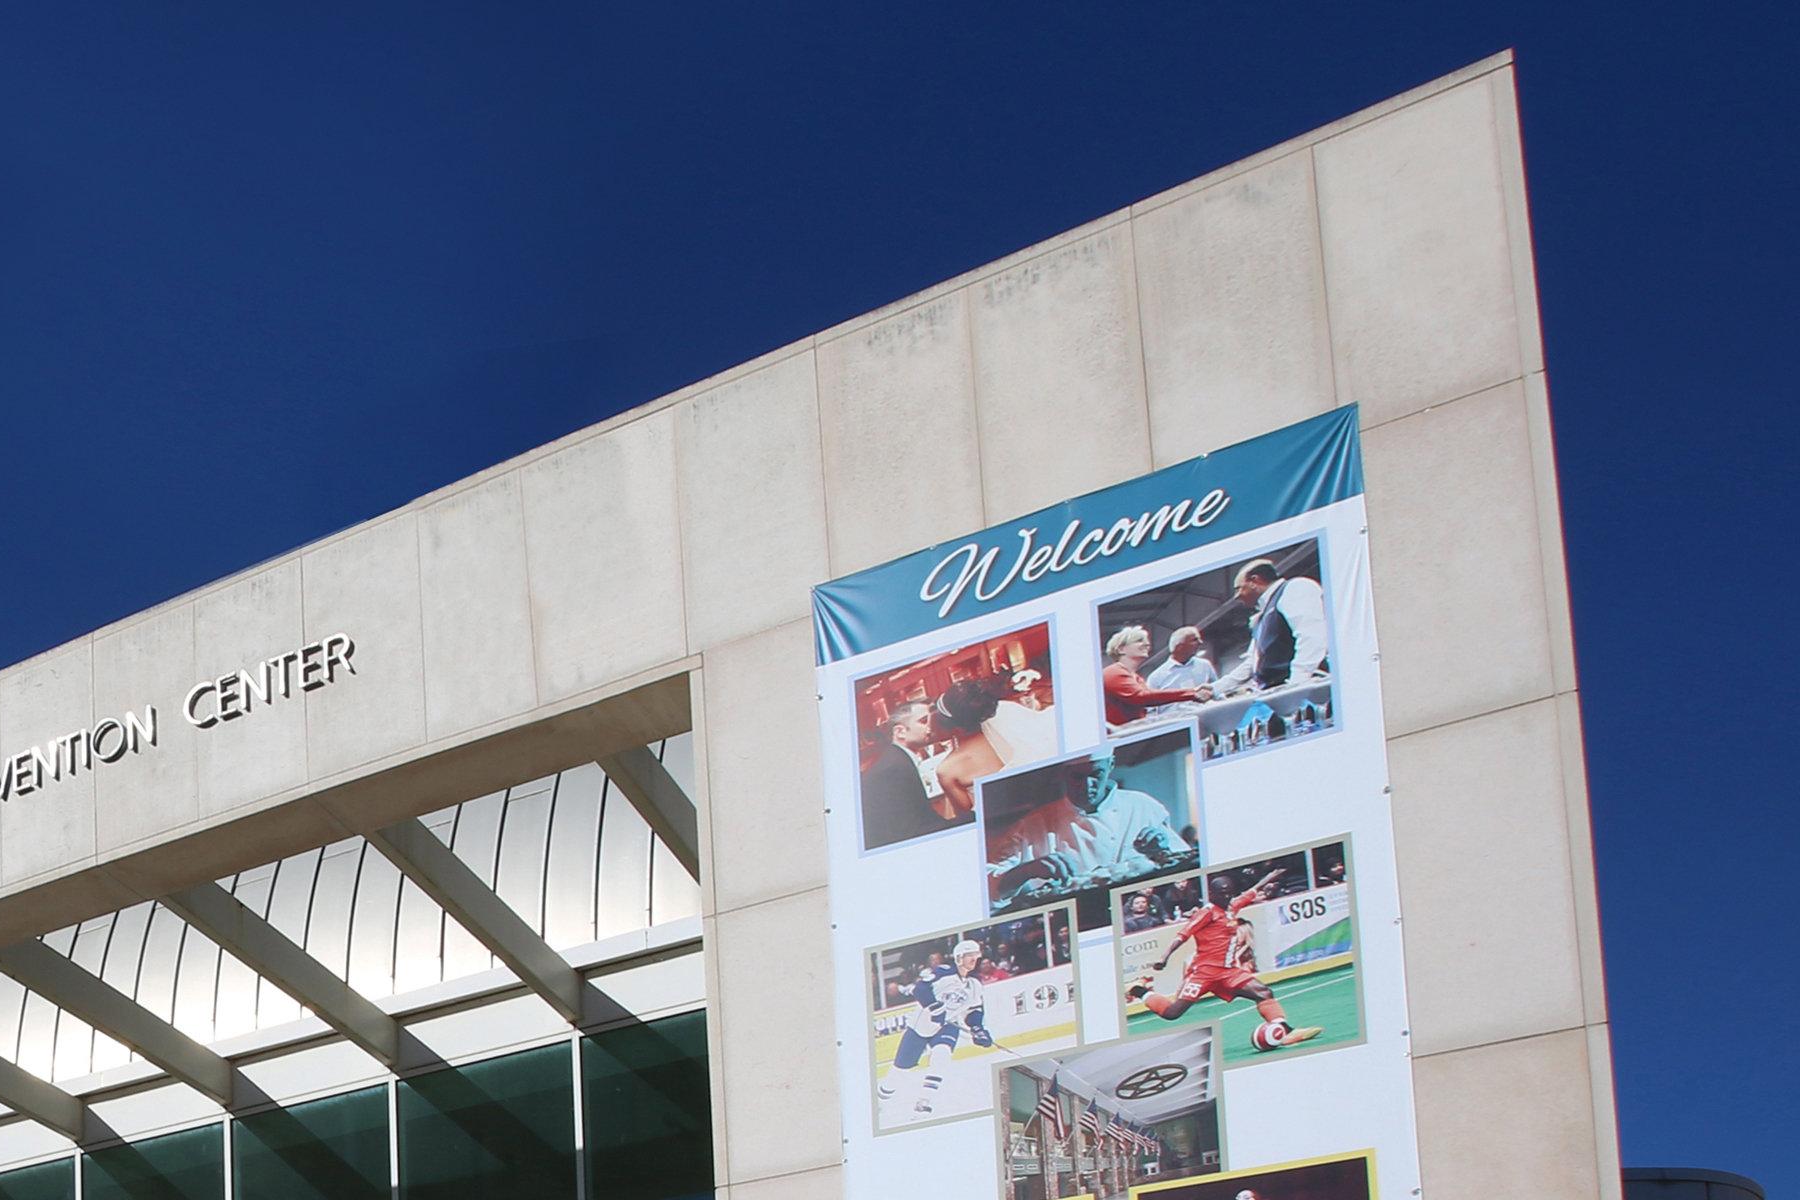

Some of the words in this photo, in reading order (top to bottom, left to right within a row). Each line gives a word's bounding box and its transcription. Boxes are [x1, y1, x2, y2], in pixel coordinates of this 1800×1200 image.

[919, 488, 1231, 618] Welcome
[183, 632, 356, 729] CENTER
[1289, 895, 1327, 923] SOS
